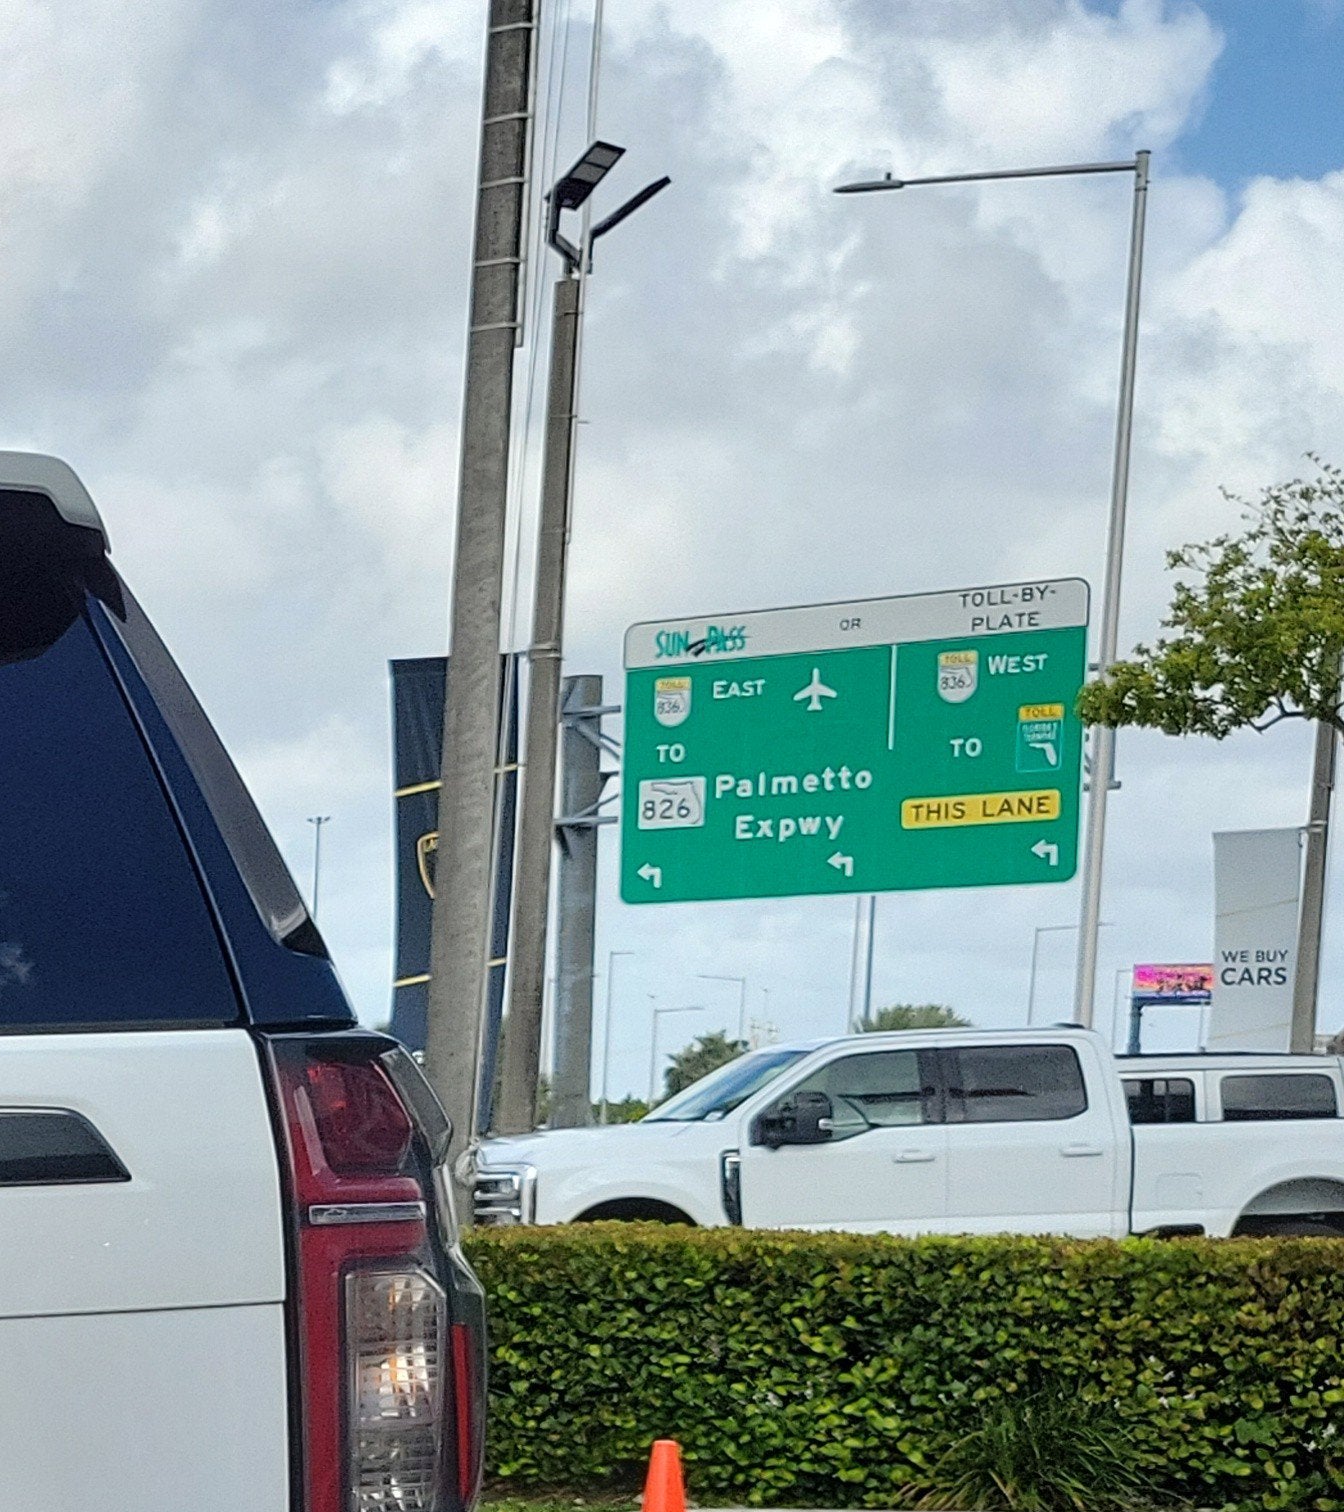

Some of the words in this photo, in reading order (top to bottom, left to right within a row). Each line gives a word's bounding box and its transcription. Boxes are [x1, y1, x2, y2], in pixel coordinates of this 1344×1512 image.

[958, 584, 1057, 609] TOLL-BY-
[839, 617, 862, 632] OR
[971, 611, 1041, 632] PLATE
[987, 653, 1048, 676] WEST
[713, 679, 766, 700] EAST
[940, 675, 967, 691] 836
[656, 743, 686, 763] TO
[950, 737, 983, 758] TO
[715, 765, 873, 799] Palmetto
[642, 798, 691, 820] 826
[911, 802, 966, 822] THIS
[981, 795, 1050, 818] LANE
[735, 813, 844, 842] Expwy
[1221, 950, 1249, 963] WE
[1255, 949, 1289, 963] BUY
[1221, 966, 1287, 986] CARS
